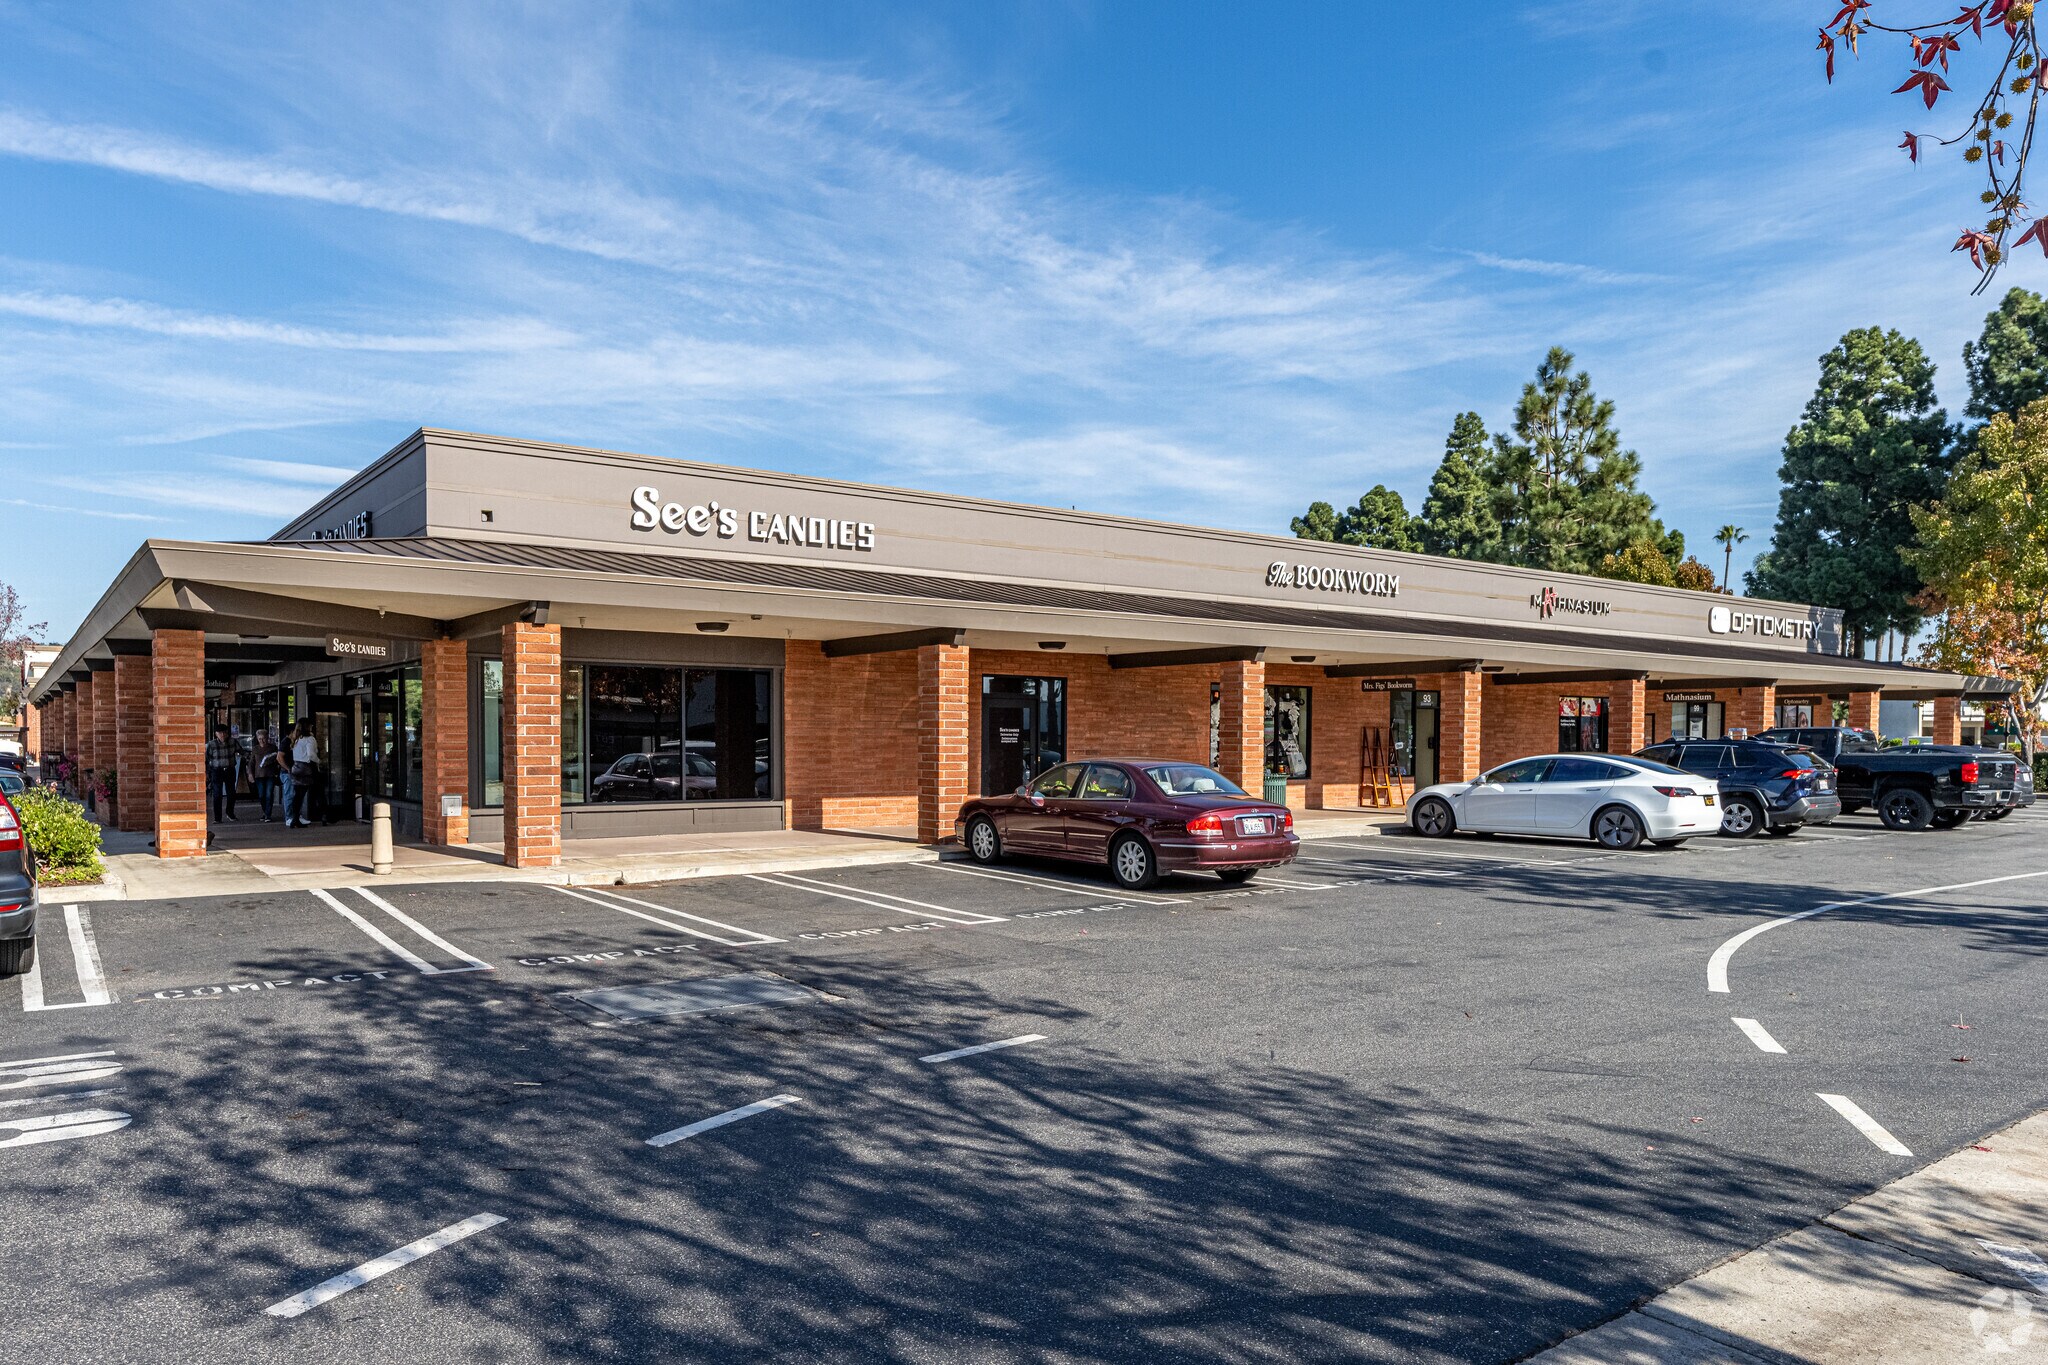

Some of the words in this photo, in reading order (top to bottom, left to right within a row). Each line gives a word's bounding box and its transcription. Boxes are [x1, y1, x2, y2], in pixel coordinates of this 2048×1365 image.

[632, 487, 738, 537] See's
[750, 511, 875, 549] CANDIES
[1268, 561, 1294, 585] The
[1296, 564, 1400, 595] BOOKWORM
[1534, 587, 1612, 617] MATHNASIUM
[1731, 612, 1822, 639] OPTOMETRY
[333, 637, 356, 653] See's
[357, 644, 386, 656] CANDIES
[1363, 682, 1374, 690] Mrs.
[1387, 681, 1413, 689] Bookworm
[1423, 694, 1432, 703] 93
[1665, 693, 1712, 701] Mathnasium
[1693, 704, 1700, 712] 99
[799, 922, 946, 939] COMPACT
[518, 943, 700, 967] COMPACT
[154, 970, 389, 999] COMPACT
